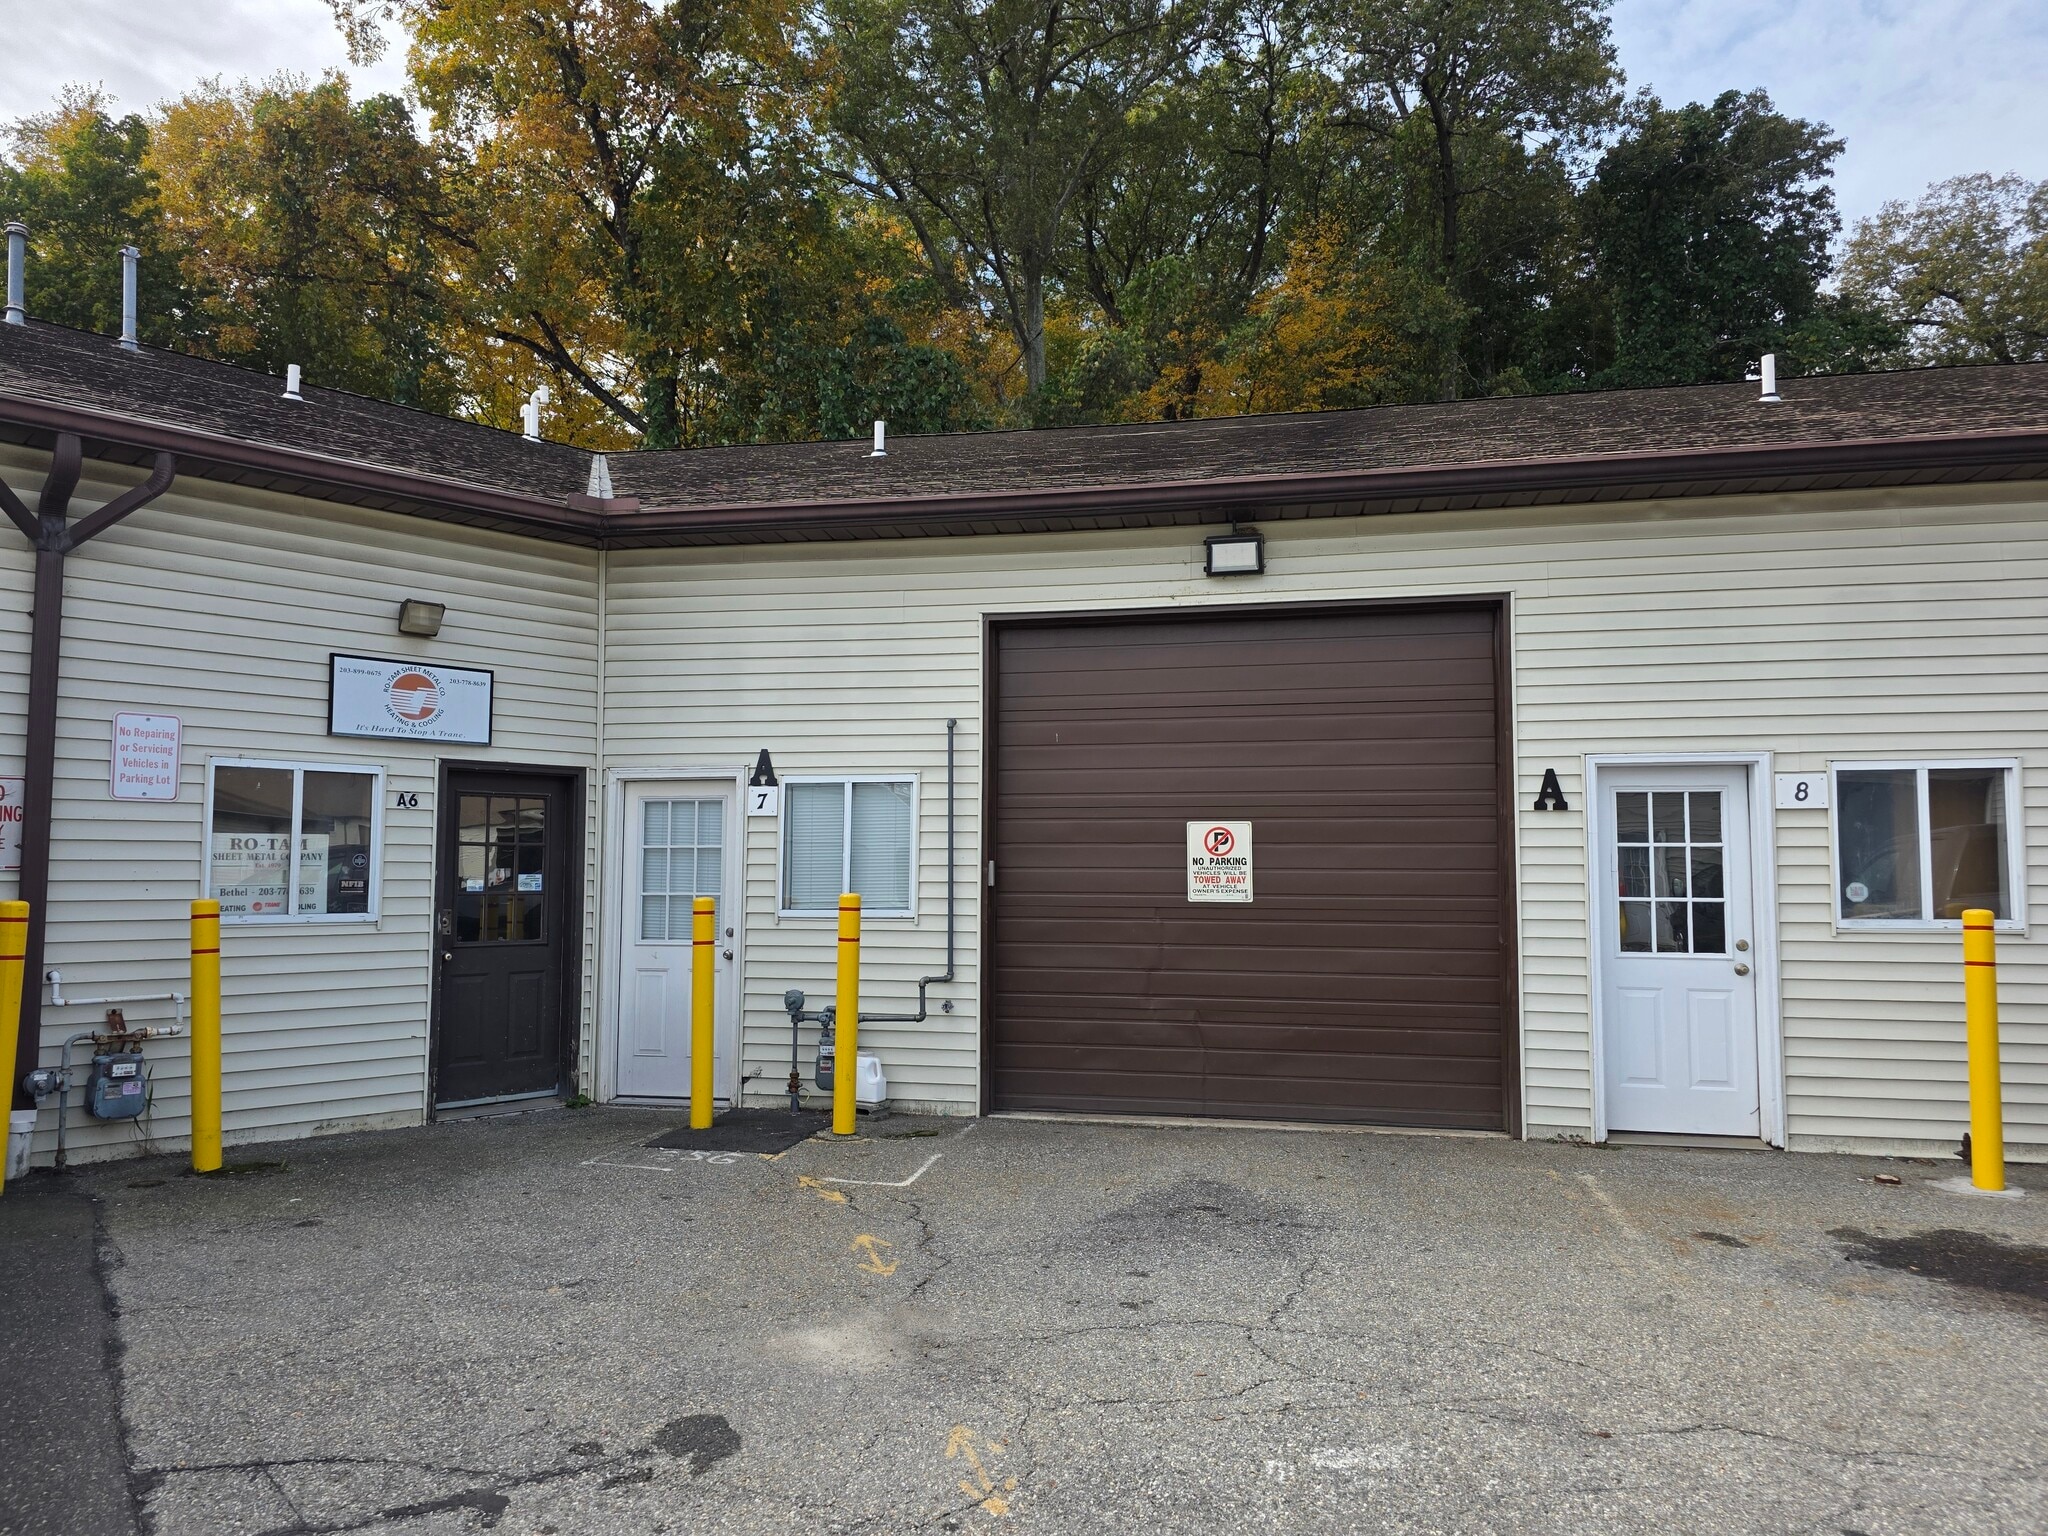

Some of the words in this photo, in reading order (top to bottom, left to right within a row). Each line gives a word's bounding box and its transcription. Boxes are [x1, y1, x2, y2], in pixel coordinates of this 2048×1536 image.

[339, 667, 382, 676] 203-899-0675
[383, 671, 402, 693] RO-TAM
[401, 666, 422, 676] SHEET
[423, 668, 441, 687] METAL
[449, 678, 487, 687] 203-778-8639
[384, 703, 410, 727] HEATING
[418, 708, 445, 728] COOLING
[119, 726, 131, 737] No
[133, 727, 175, 741] Repairing
[371, 725, 395, 733] Hard
[396, 726, 407, 734] To
[408, 727, 428, 737] Stop
[120, 743, 130, 752] or
[132, 742, 174, 756] Servicing
[122, 757, 159, 769] Vehicles
[161, 760, 169, 770] in
[750, 748, 778, 786] A
[120, 772, 155, 786] Parking
[156, 775, 171, 785] Lot
[1533, 767, 1569, 811] A
[1794, 781, 1810, 803] 8
[396, 791, 419, 809] A6
[756, 793, 769, 810] 7
[212, 852, 242, 861] SHEET
[247, 852, 276, 861] METAL
[280, 852, 323, 861] COPANY
[1192, 857, 1204, 865] NO
[1210, 857, 1247, 865] PARKING
[219, 887, 248, 897] Bethel
